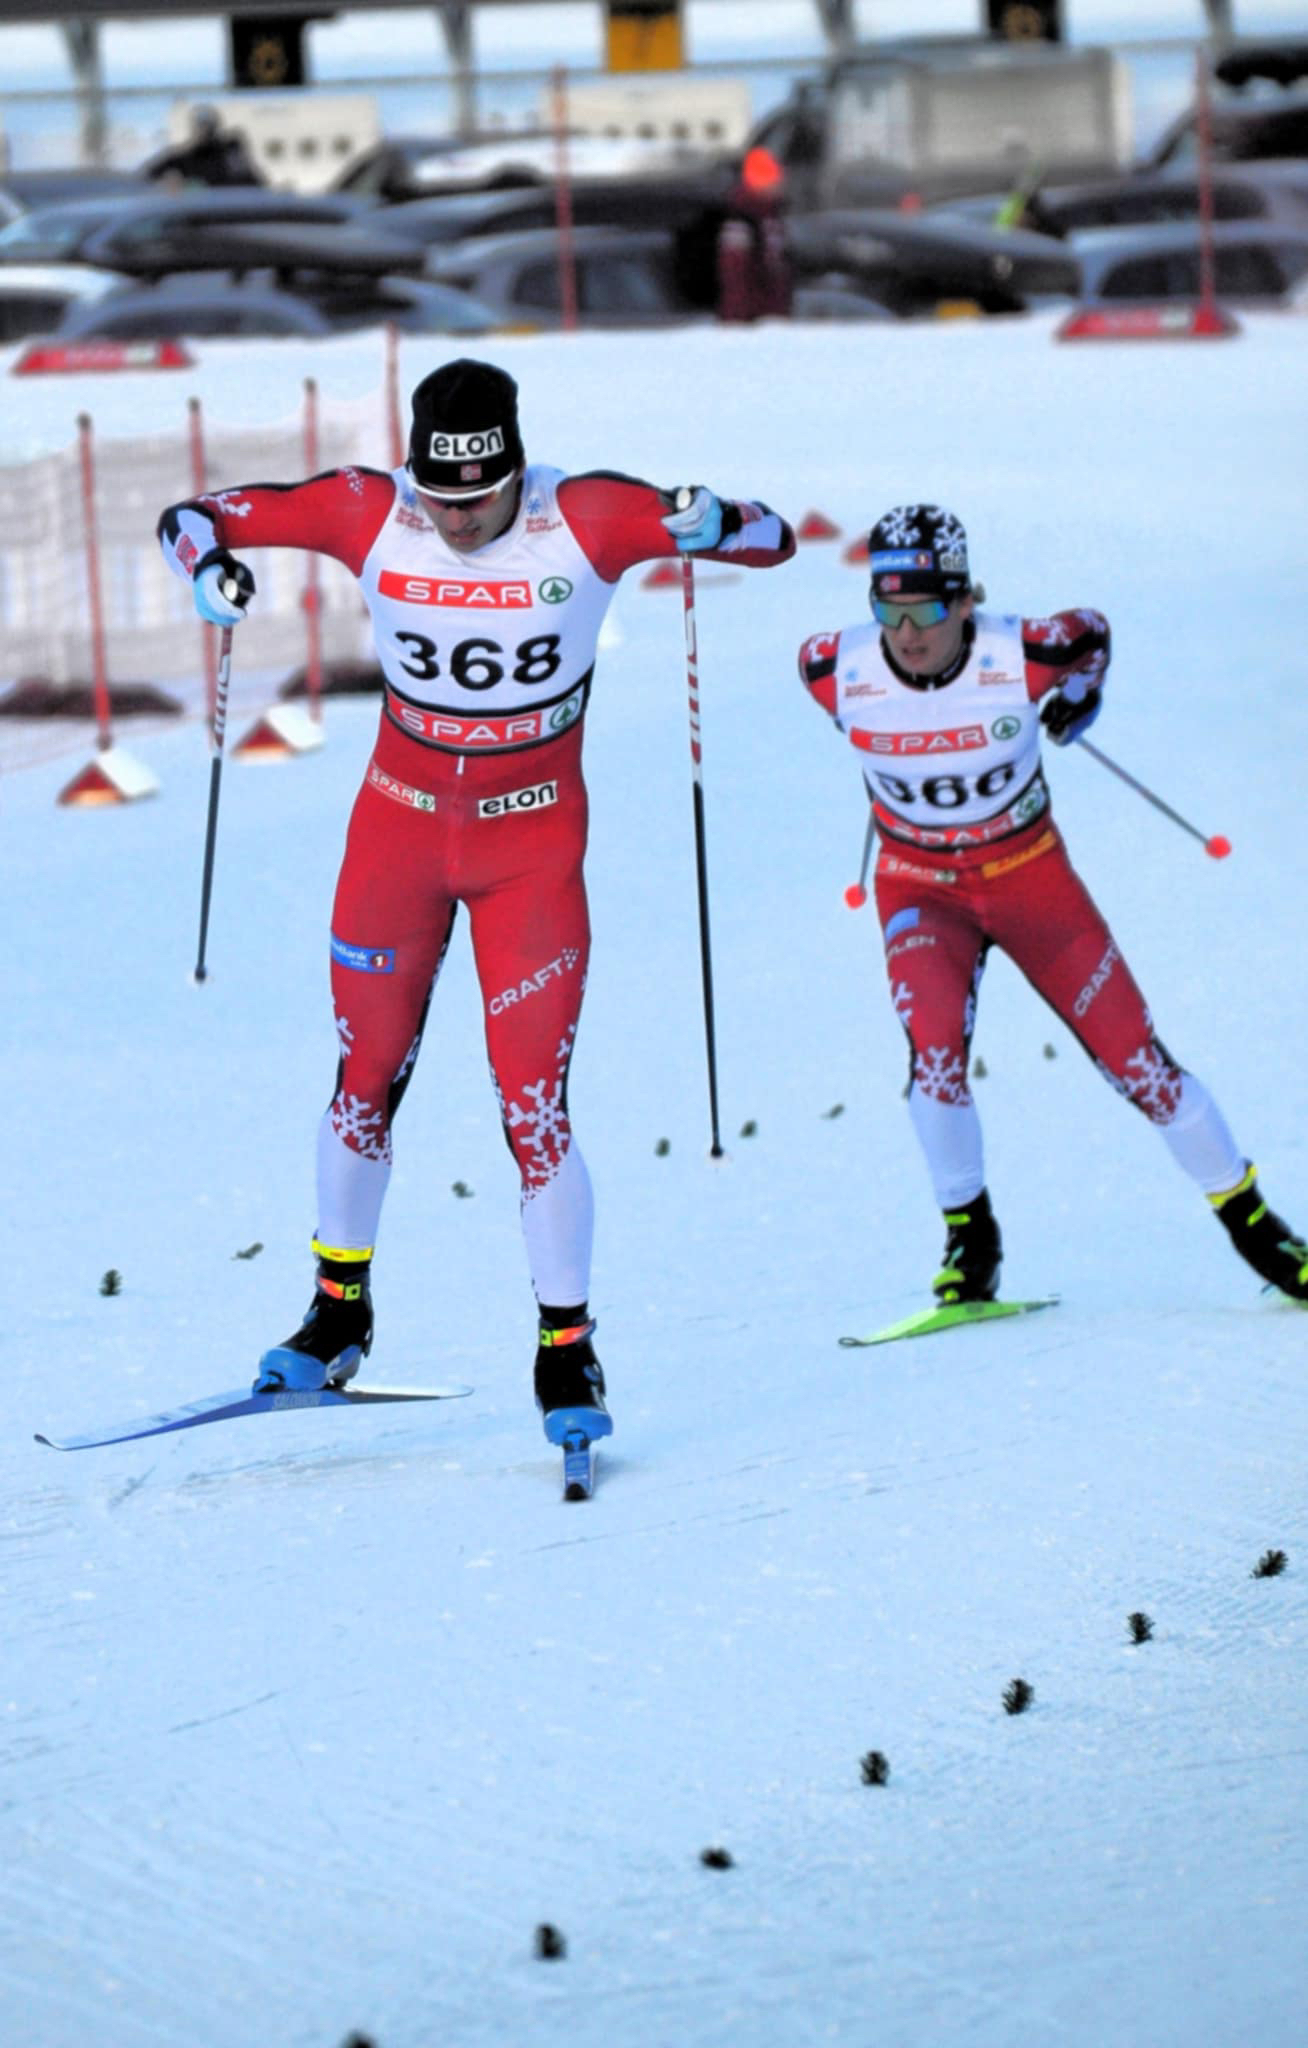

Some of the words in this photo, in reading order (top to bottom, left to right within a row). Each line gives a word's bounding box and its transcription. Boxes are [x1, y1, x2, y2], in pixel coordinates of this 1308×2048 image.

[403, 580, 529, 605] SPAR
[394, 630, 563, 691] 368
[400, 707, 536, 743] SPAR
[870, 727, 984, 752] SPAR
[370, 766, 416, 804] SPAR
[488, 957, 565, 1017] CRAFT
